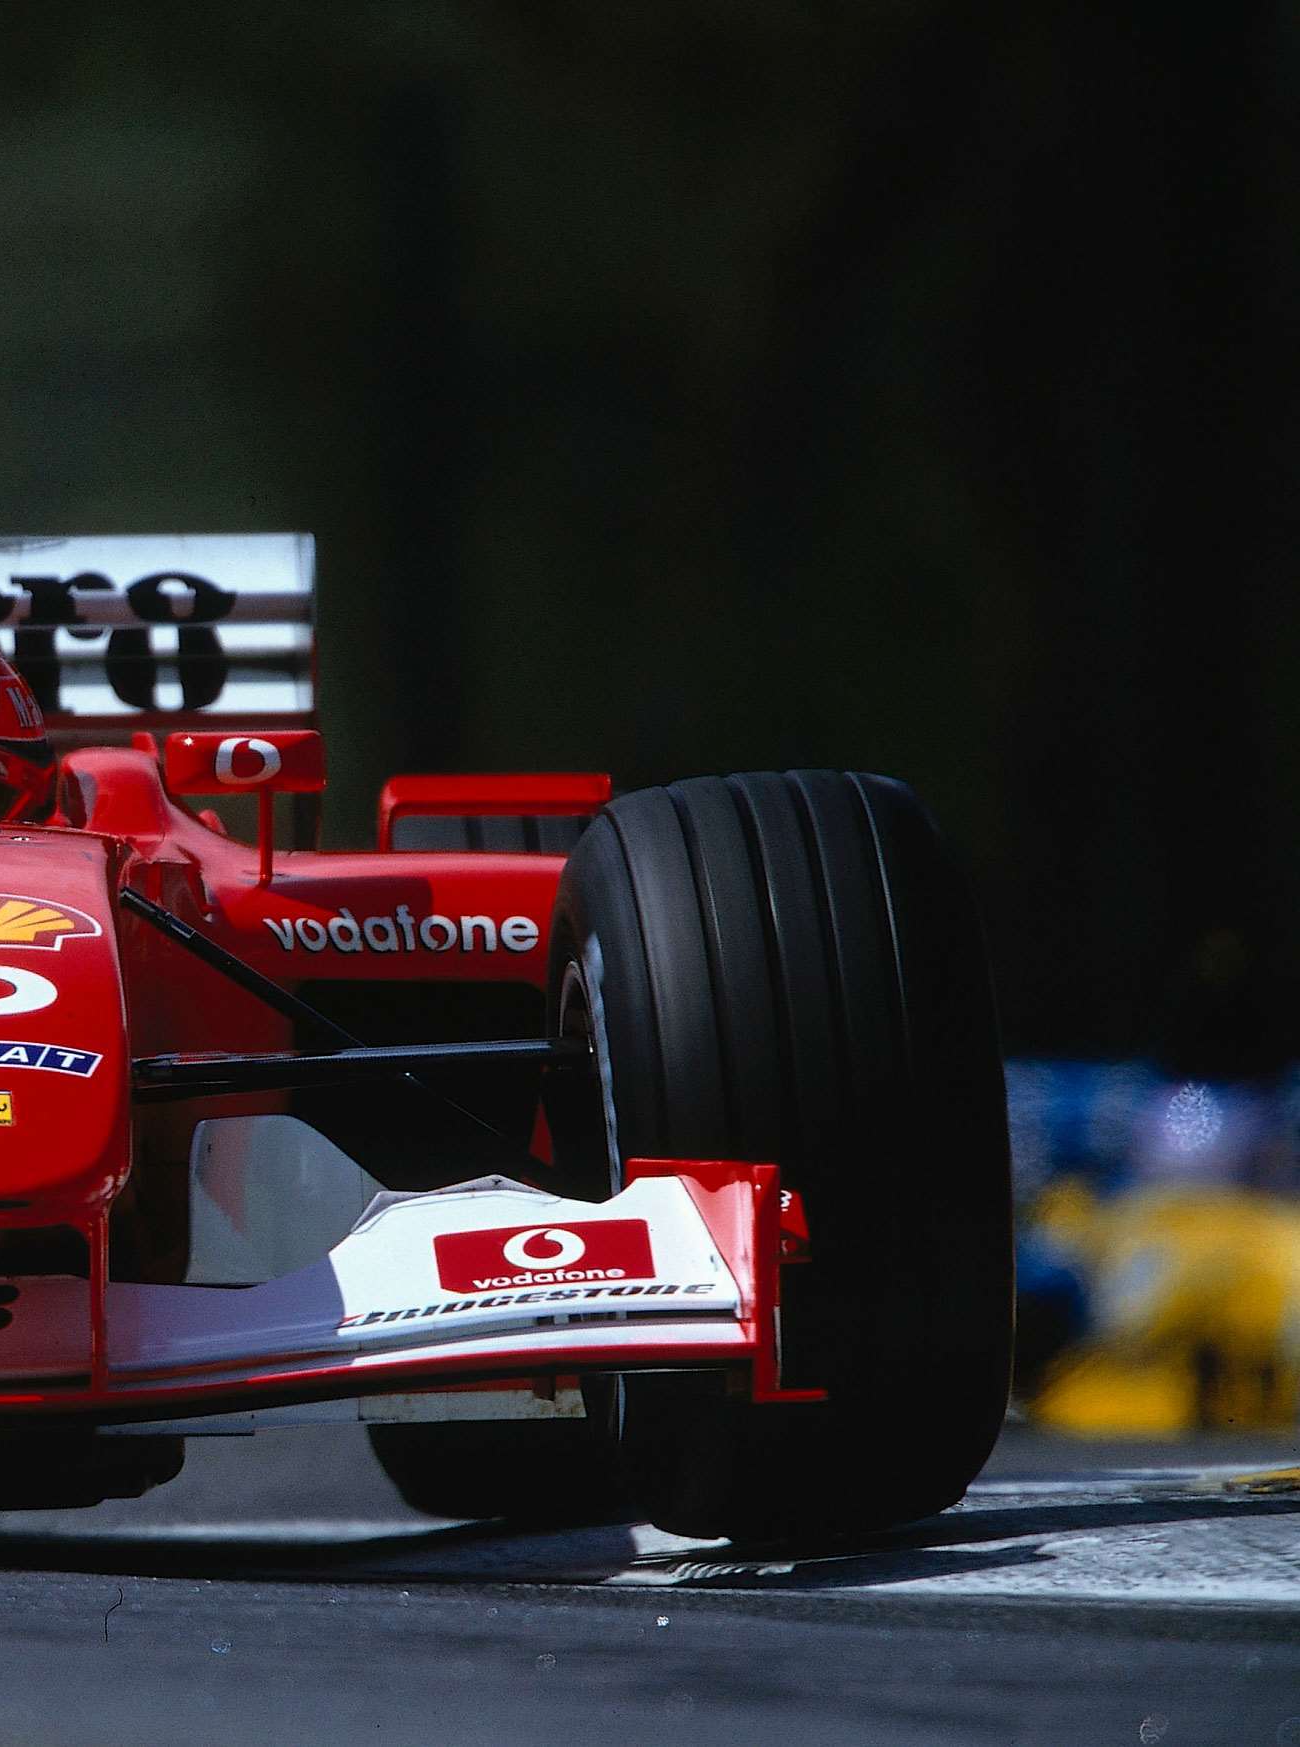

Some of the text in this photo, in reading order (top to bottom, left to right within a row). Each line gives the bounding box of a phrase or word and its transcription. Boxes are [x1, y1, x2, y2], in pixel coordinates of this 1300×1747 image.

[262, 903, 540, 952] vodafone
[472, 1265, 626, 1290] vodafone
[334, 1283, 717, 1330] BRIDGESTONE
